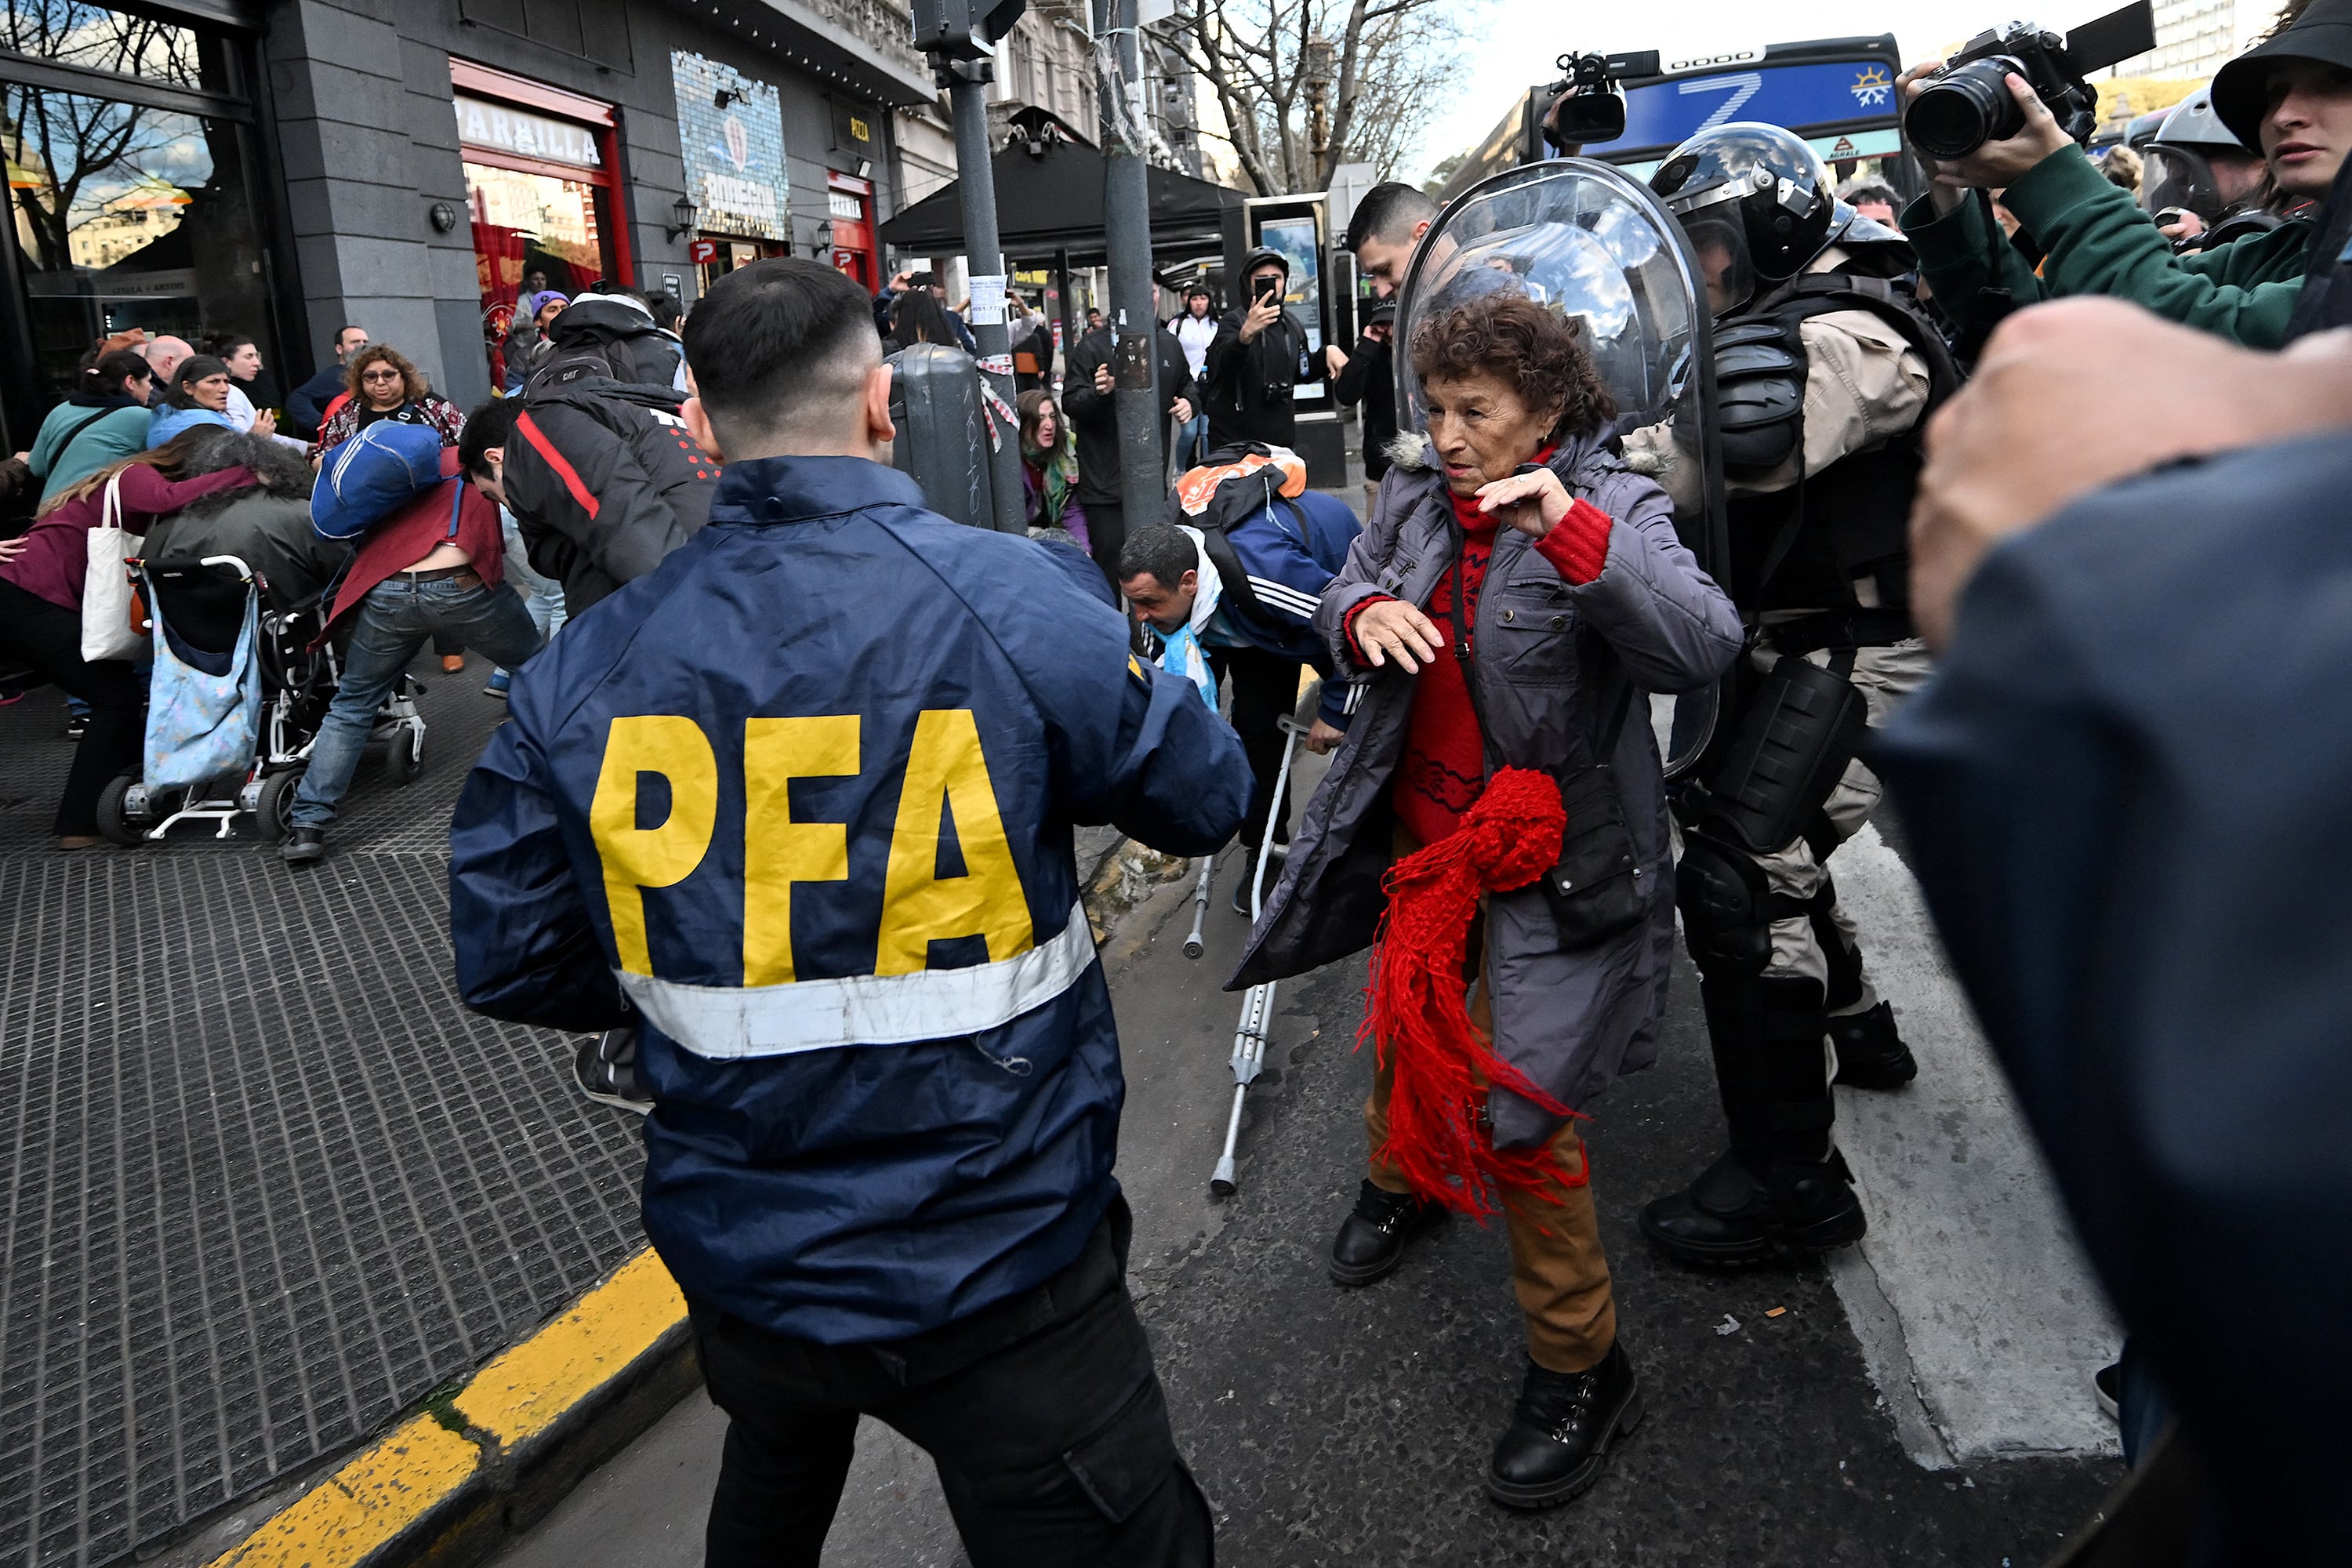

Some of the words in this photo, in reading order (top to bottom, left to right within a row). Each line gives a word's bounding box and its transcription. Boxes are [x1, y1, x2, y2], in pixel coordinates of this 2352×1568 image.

[1679, 73, 1762, 135] 7
[851, 117, 869, 143] PIZZA
[1830, 150, 1860, 158] AGRALE
[563, 369, 579, 381] CAT
[590, 708, 1035, 987] PFA
